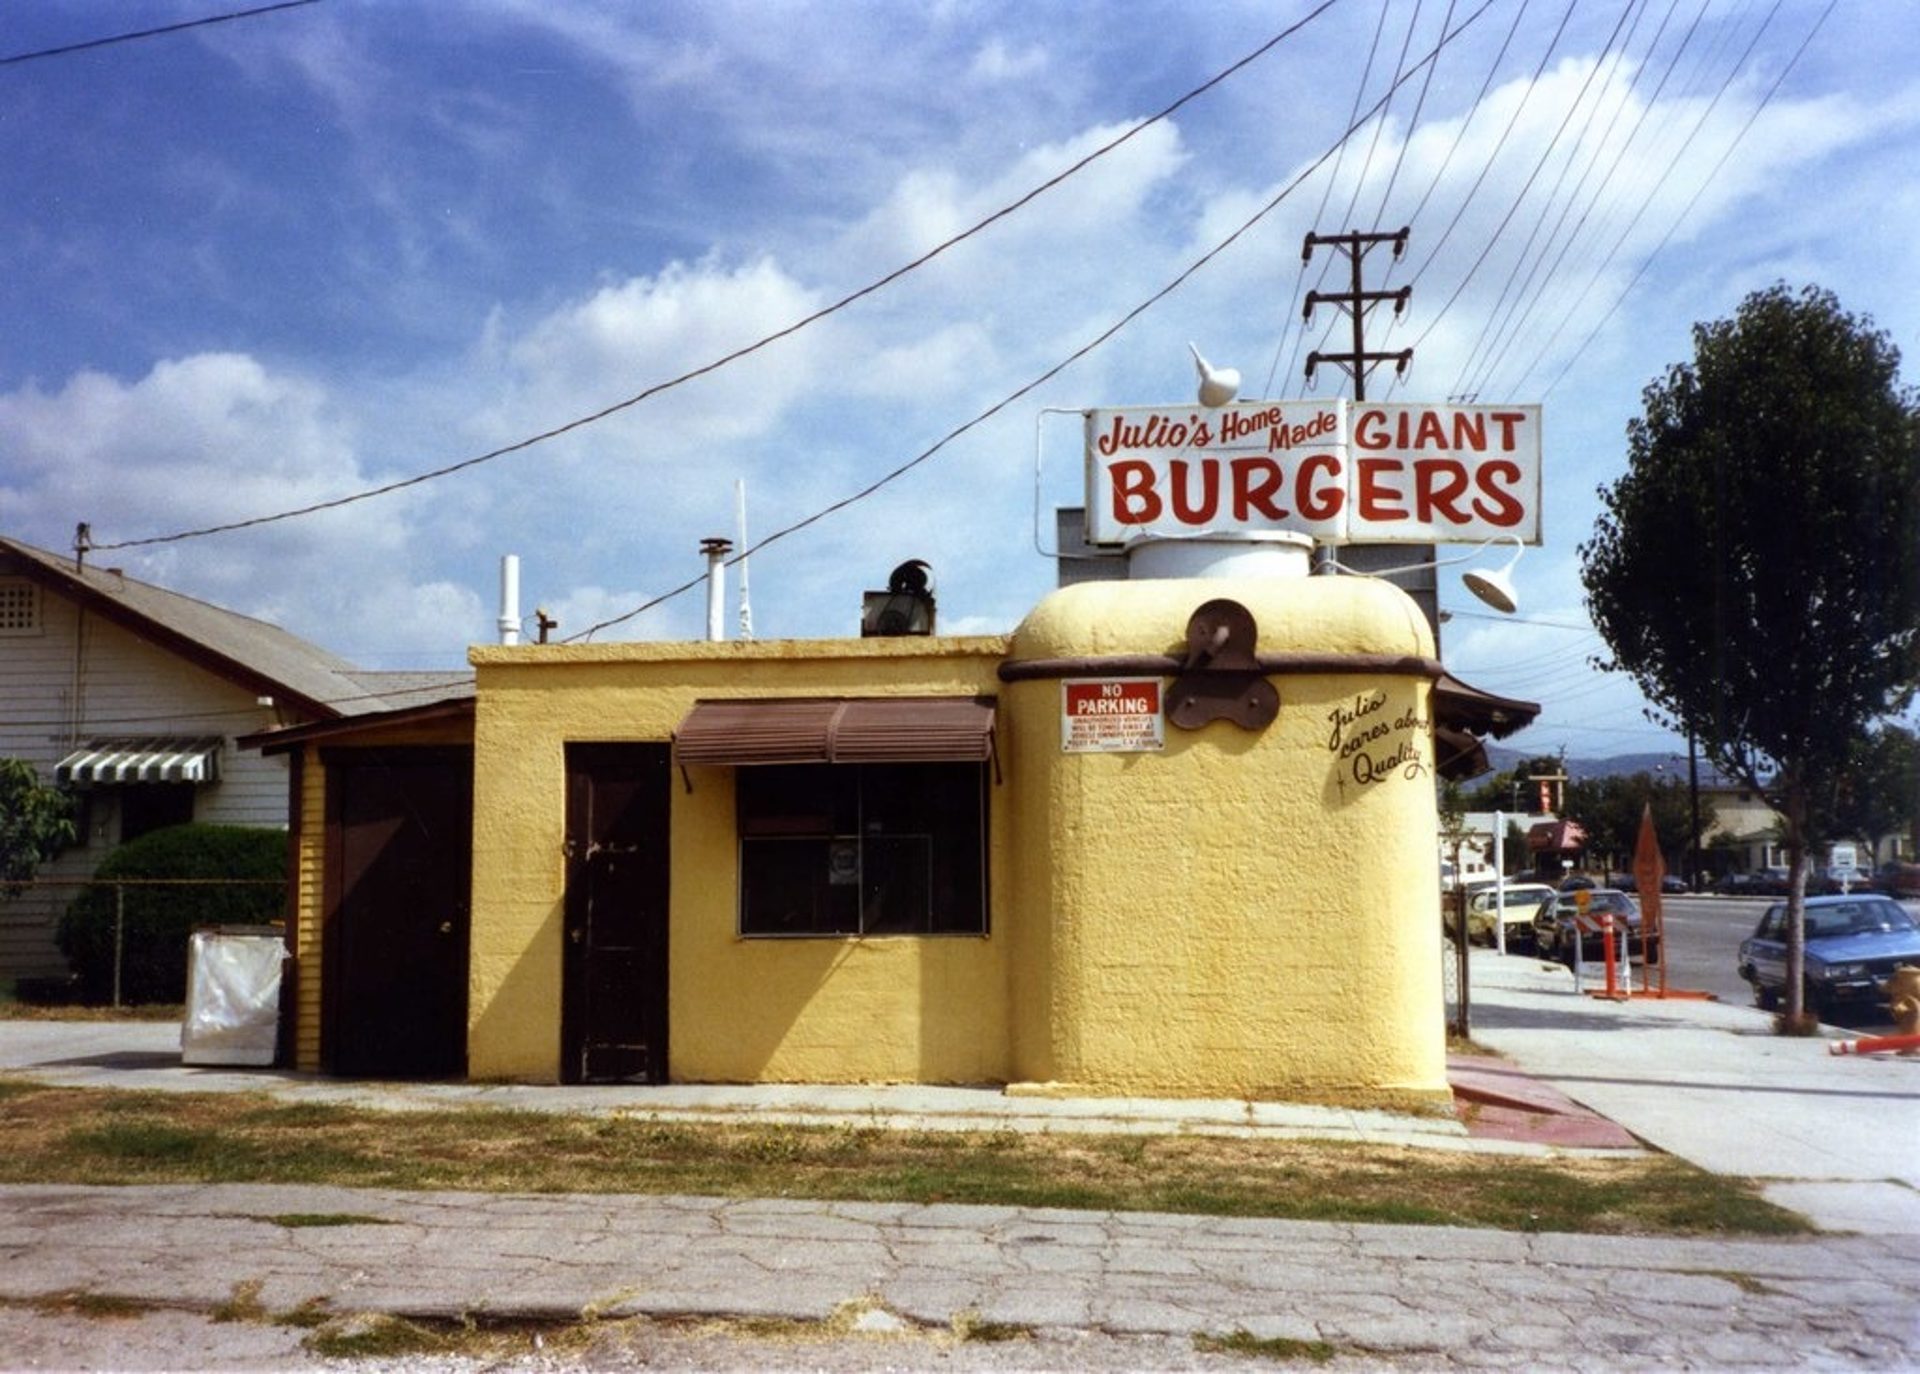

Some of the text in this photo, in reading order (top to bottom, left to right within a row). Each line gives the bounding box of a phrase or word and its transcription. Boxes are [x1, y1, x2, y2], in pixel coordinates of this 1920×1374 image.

[1099, 407, 1526, 456] Julio's Home Made GIANT
[1107, 454, 1525, 528] BURGERS
[1077, 698, 1148, 714] PARKING
[1102, 684, 1122, 697] NO
[1328, 693, 1387, 752] Julio
[1340, 722, 1390, 759] cares
[1353, 742, 1427, 785] Quality
